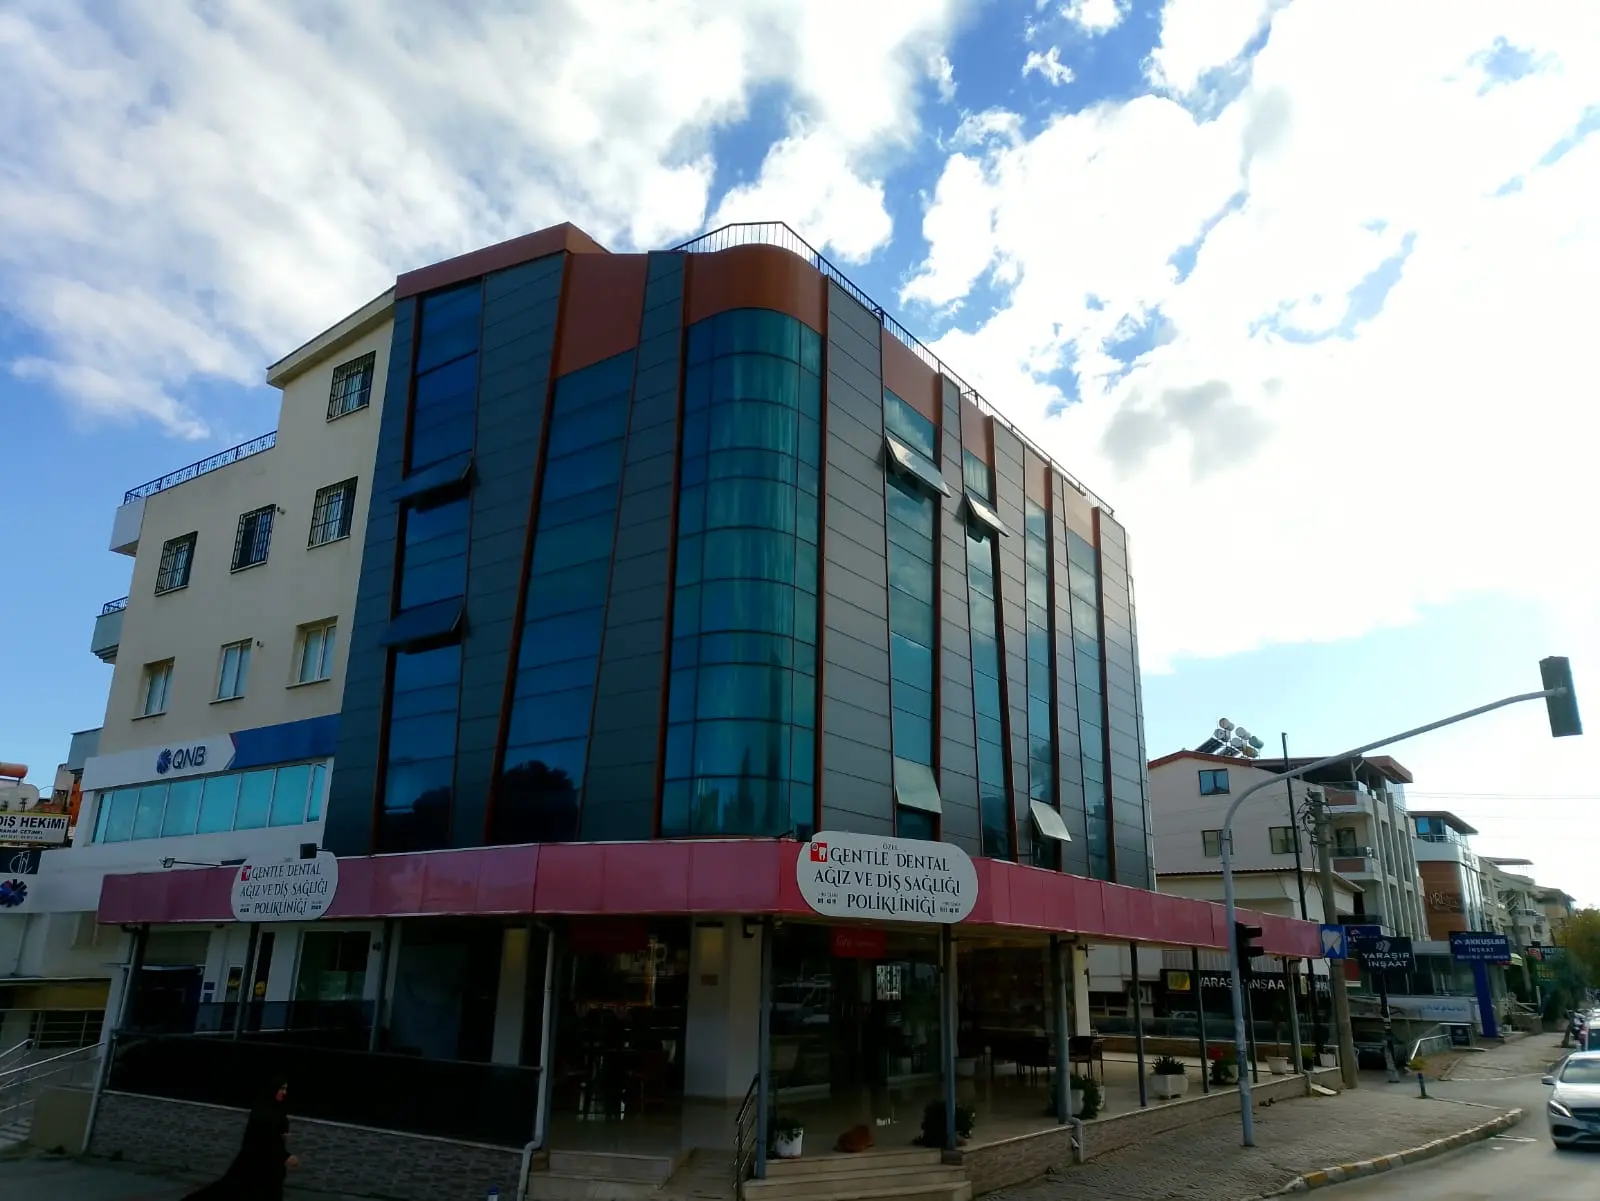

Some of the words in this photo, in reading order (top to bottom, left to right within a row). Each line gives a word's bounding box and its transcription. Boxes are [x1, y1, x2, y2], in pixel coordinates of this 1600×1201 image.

[172, 745, 206, 769] QNB
[830, 847, 889, 866] GENTLE
[895, 853, 950, 872] DENTAL
[252, 865, 284, 881] GENTLE
[287, 862, 321, 877] DENTAL
[814, 866, 851, 888] AĞIZ
[854, 871, 873, 887] VE
[876, 870, 901, 894] DİŞ
[904, 874, 961, 897] SAĞLIĞI
[240, 882, 260, 899] AĞIZ
[260, 884, 274, 896] VE
[274, 880, 288, 898] DİŞ
[290, 878, 328, 896] SAĞLIĞI
[254, 898, 307, 916] POLİKLİNİĞİ
[847, 892, 936, 918] POLİKLİNİĞİ
[1362, 952, 1410, 961] YARAŞIR
[1368, 959, 1408, 969] İNŞAAT
